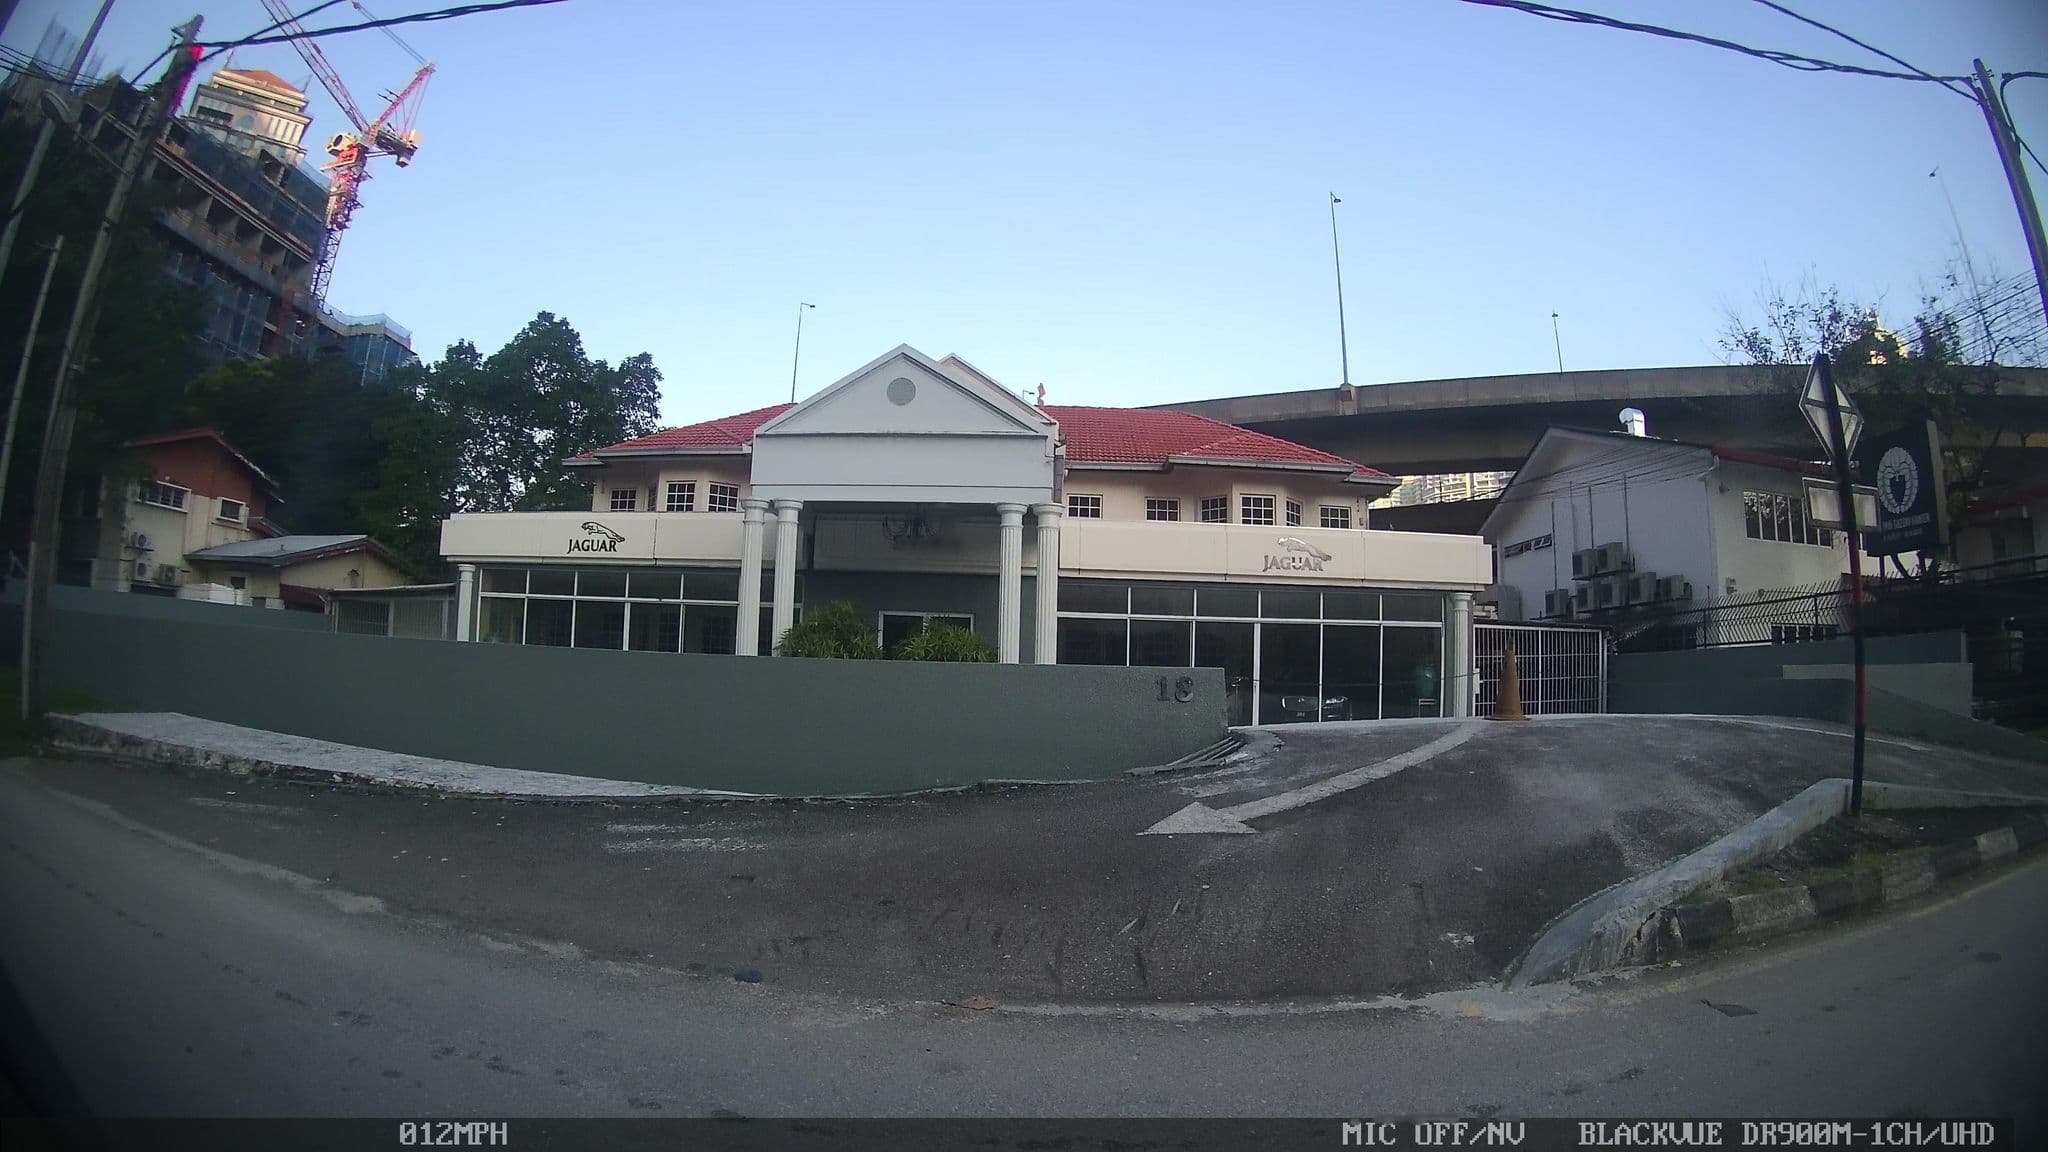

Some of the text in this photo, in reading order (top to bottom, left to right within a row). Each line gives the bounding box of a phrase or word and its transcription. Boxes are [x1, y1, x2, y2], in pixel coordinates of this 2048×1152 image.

[567, 539, 617, 554] JAGUAR
[1262, 555, 1324, 572] JAGUAR
[1156, 676, 1193, 703] 18
